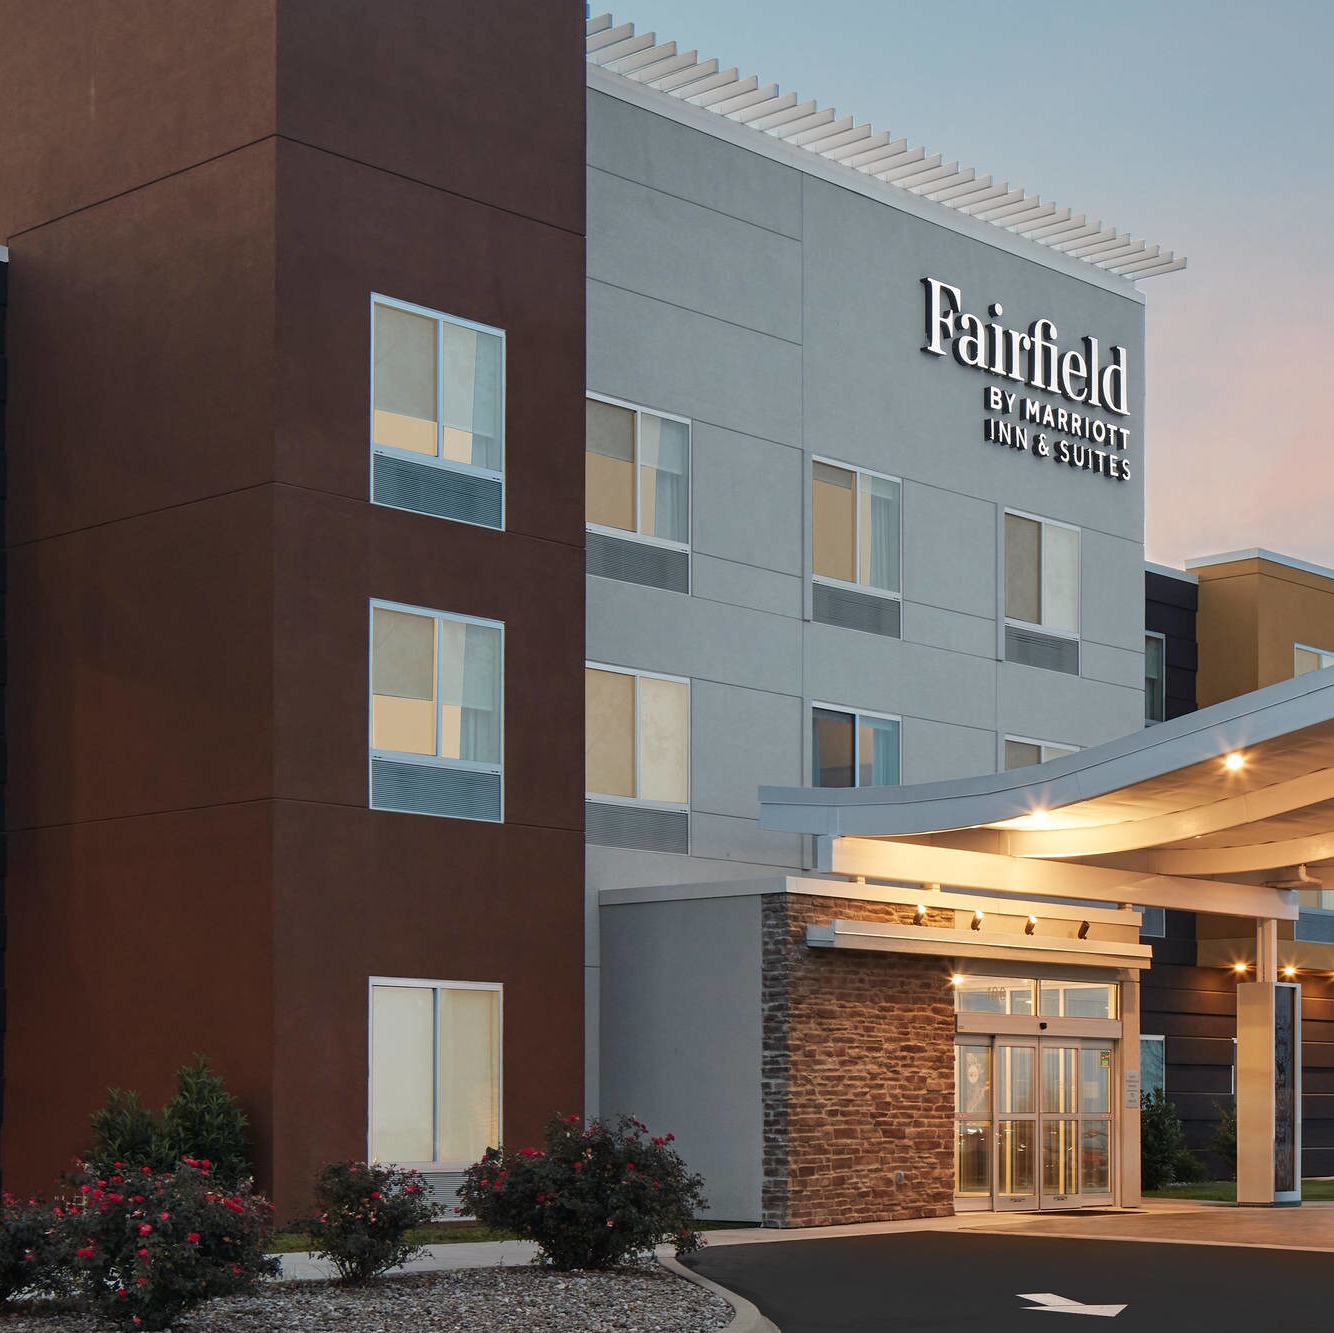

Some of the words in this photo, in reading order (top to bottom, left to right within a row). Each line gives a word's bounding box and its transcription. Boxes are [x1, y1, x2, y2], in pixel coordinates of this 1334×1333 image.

[921, 278, 1130, 416] Fairfield
[985, 386, 1016, 415] BY
[1021, 398, 1130, 450] MARRIOTT
[985, 418, 1028, 450] INN
[1033, 433, 1049, 457] &
[1055, 440, 1130, 480] SUITES
